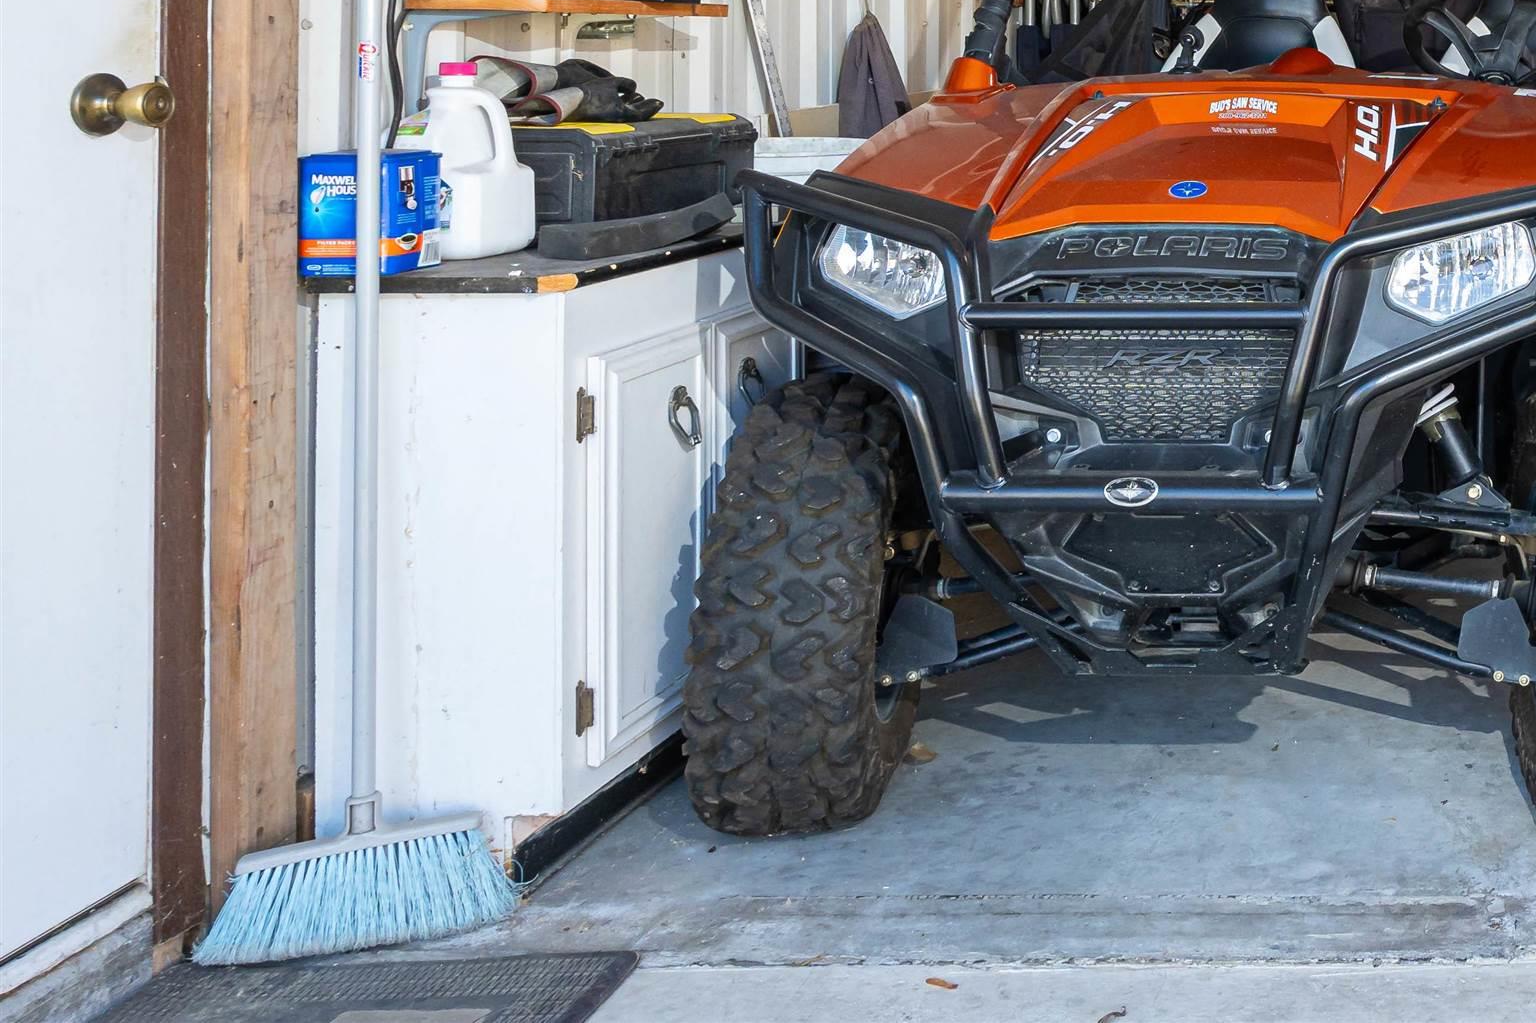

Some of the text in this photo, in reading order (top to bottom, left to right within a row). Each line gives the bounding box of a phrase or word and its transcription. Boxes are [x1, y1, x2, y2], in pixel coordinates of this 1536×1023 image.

[1209, 96, 1279, 114] BUD'S SAW SERVICE
[1047, 101, 1132, 156] H.O.
[1353, 104, 1380, 162] H.O.
[311, 175, 357, 186] MAXWEL
[325, 185, 357, 197] HOUS
[1055, 235, 1290, 261] POLARIS
[1103, 349, 1225, 369] RZR
